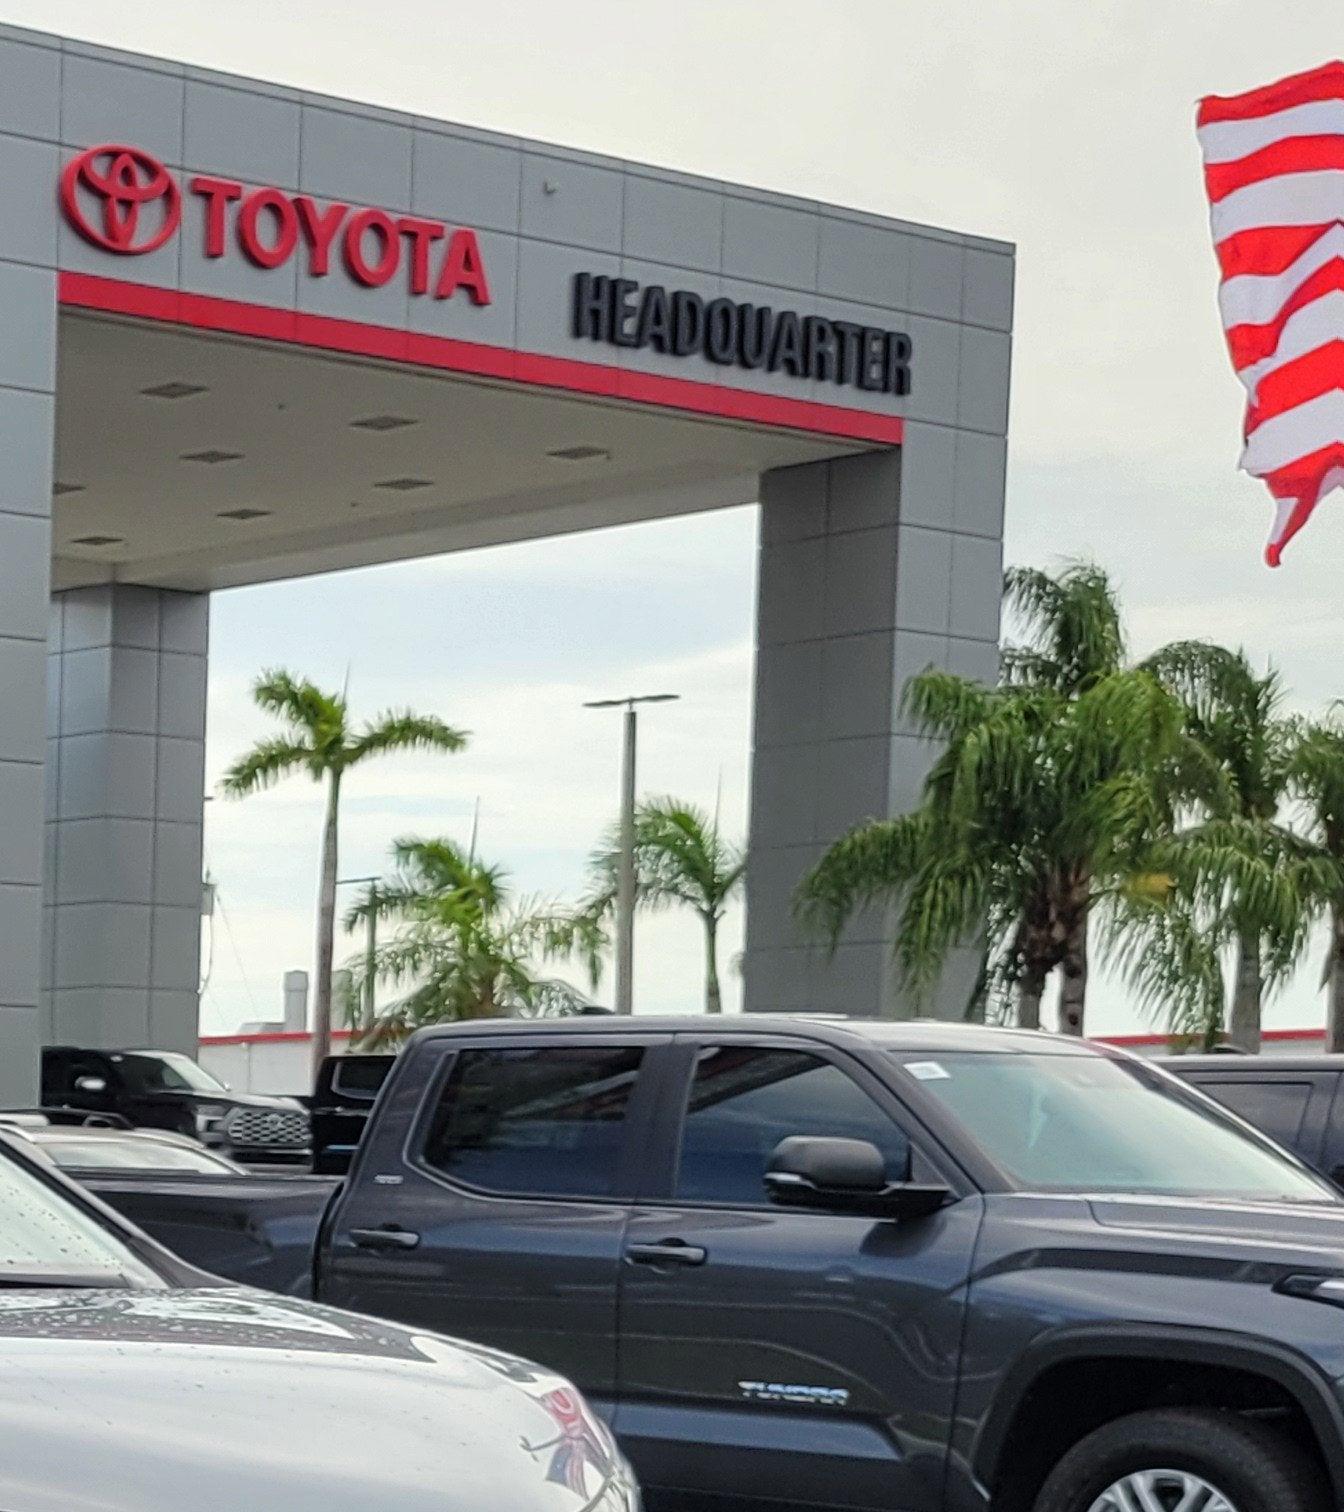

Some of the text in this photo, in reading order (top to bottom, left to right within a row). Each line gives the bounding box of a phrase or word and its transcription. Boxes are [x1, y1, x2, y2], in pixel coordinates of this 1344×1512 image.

[190, 177, 491, 307] TOYOTA
[571, 272, 914, 396] HEADQUARTER
[738, 1380, 850, 1407] TUNDRA
